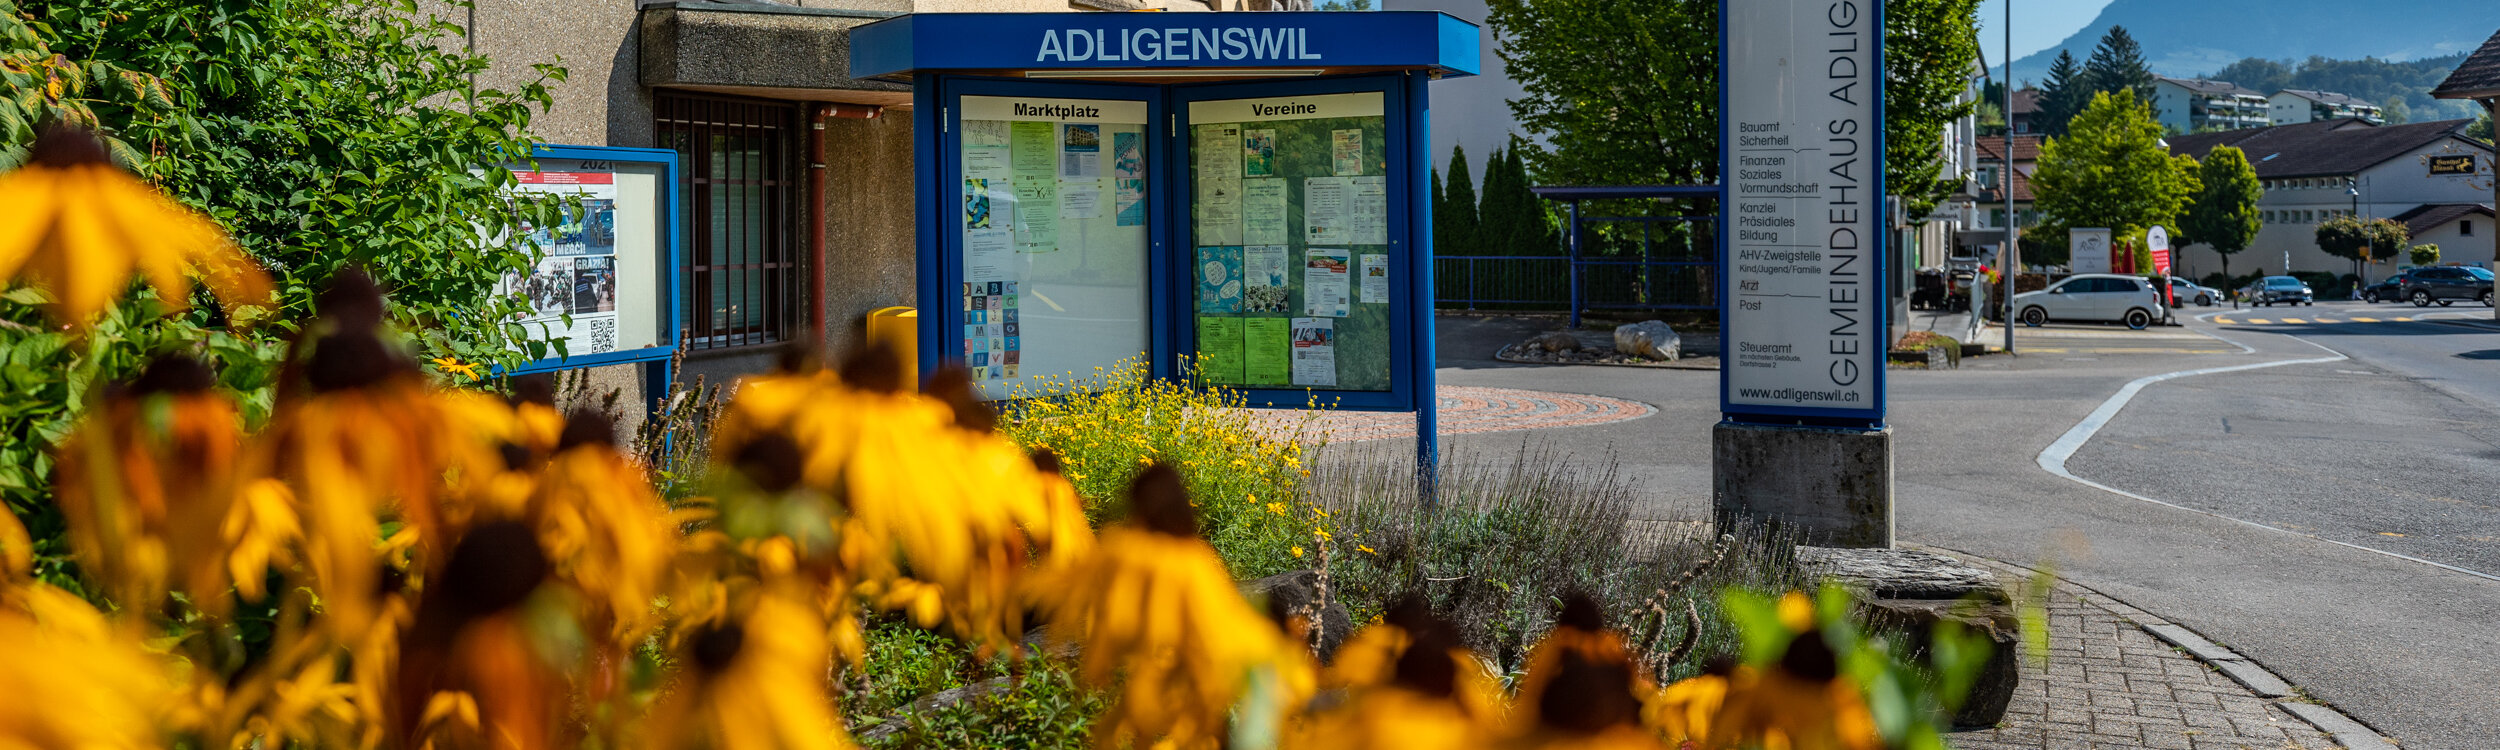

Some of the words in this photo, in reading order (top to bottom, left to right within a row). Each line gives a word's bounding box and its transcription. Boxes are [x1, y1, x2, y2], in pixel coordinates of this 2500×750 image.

[1036, 28, 1322, 62] ADLIGENSWIL
[1014, 103, 1100, 120] Marktplatz
[1252, 101, 1317, 117] Vereine
[1740, 121, 1780, 133] Bauamt
[1739, 135, 1789, 146] Sicherheit
[1740, 156, 1786, 166] Finanzen
[1739, 170, 1782, 180] Soziales
[1739, 183, 1819, 194] Vormundschaft
[1740, 203, 1776, 213] Kanzlei
[1740, 216, 1795, 228] Präsidiales
[1740, 230, 1778, 243] Bildung
[556, 243, 586, 255] MERCI!
[1829, 119, 1859, 387] GEMEINDEHAUS
[1739, 250, 1821, 263] AHV-Zweigstelle
[576, 258, 610, 270] GRAZIA!
[1739, 280, 1760, 291] Arzt
[1740, 300, 1762, 311] Post
[1739, 342, 1792, 354] Steueramt
[1740, 388, 1859, 403] www.adligenswil.ch
